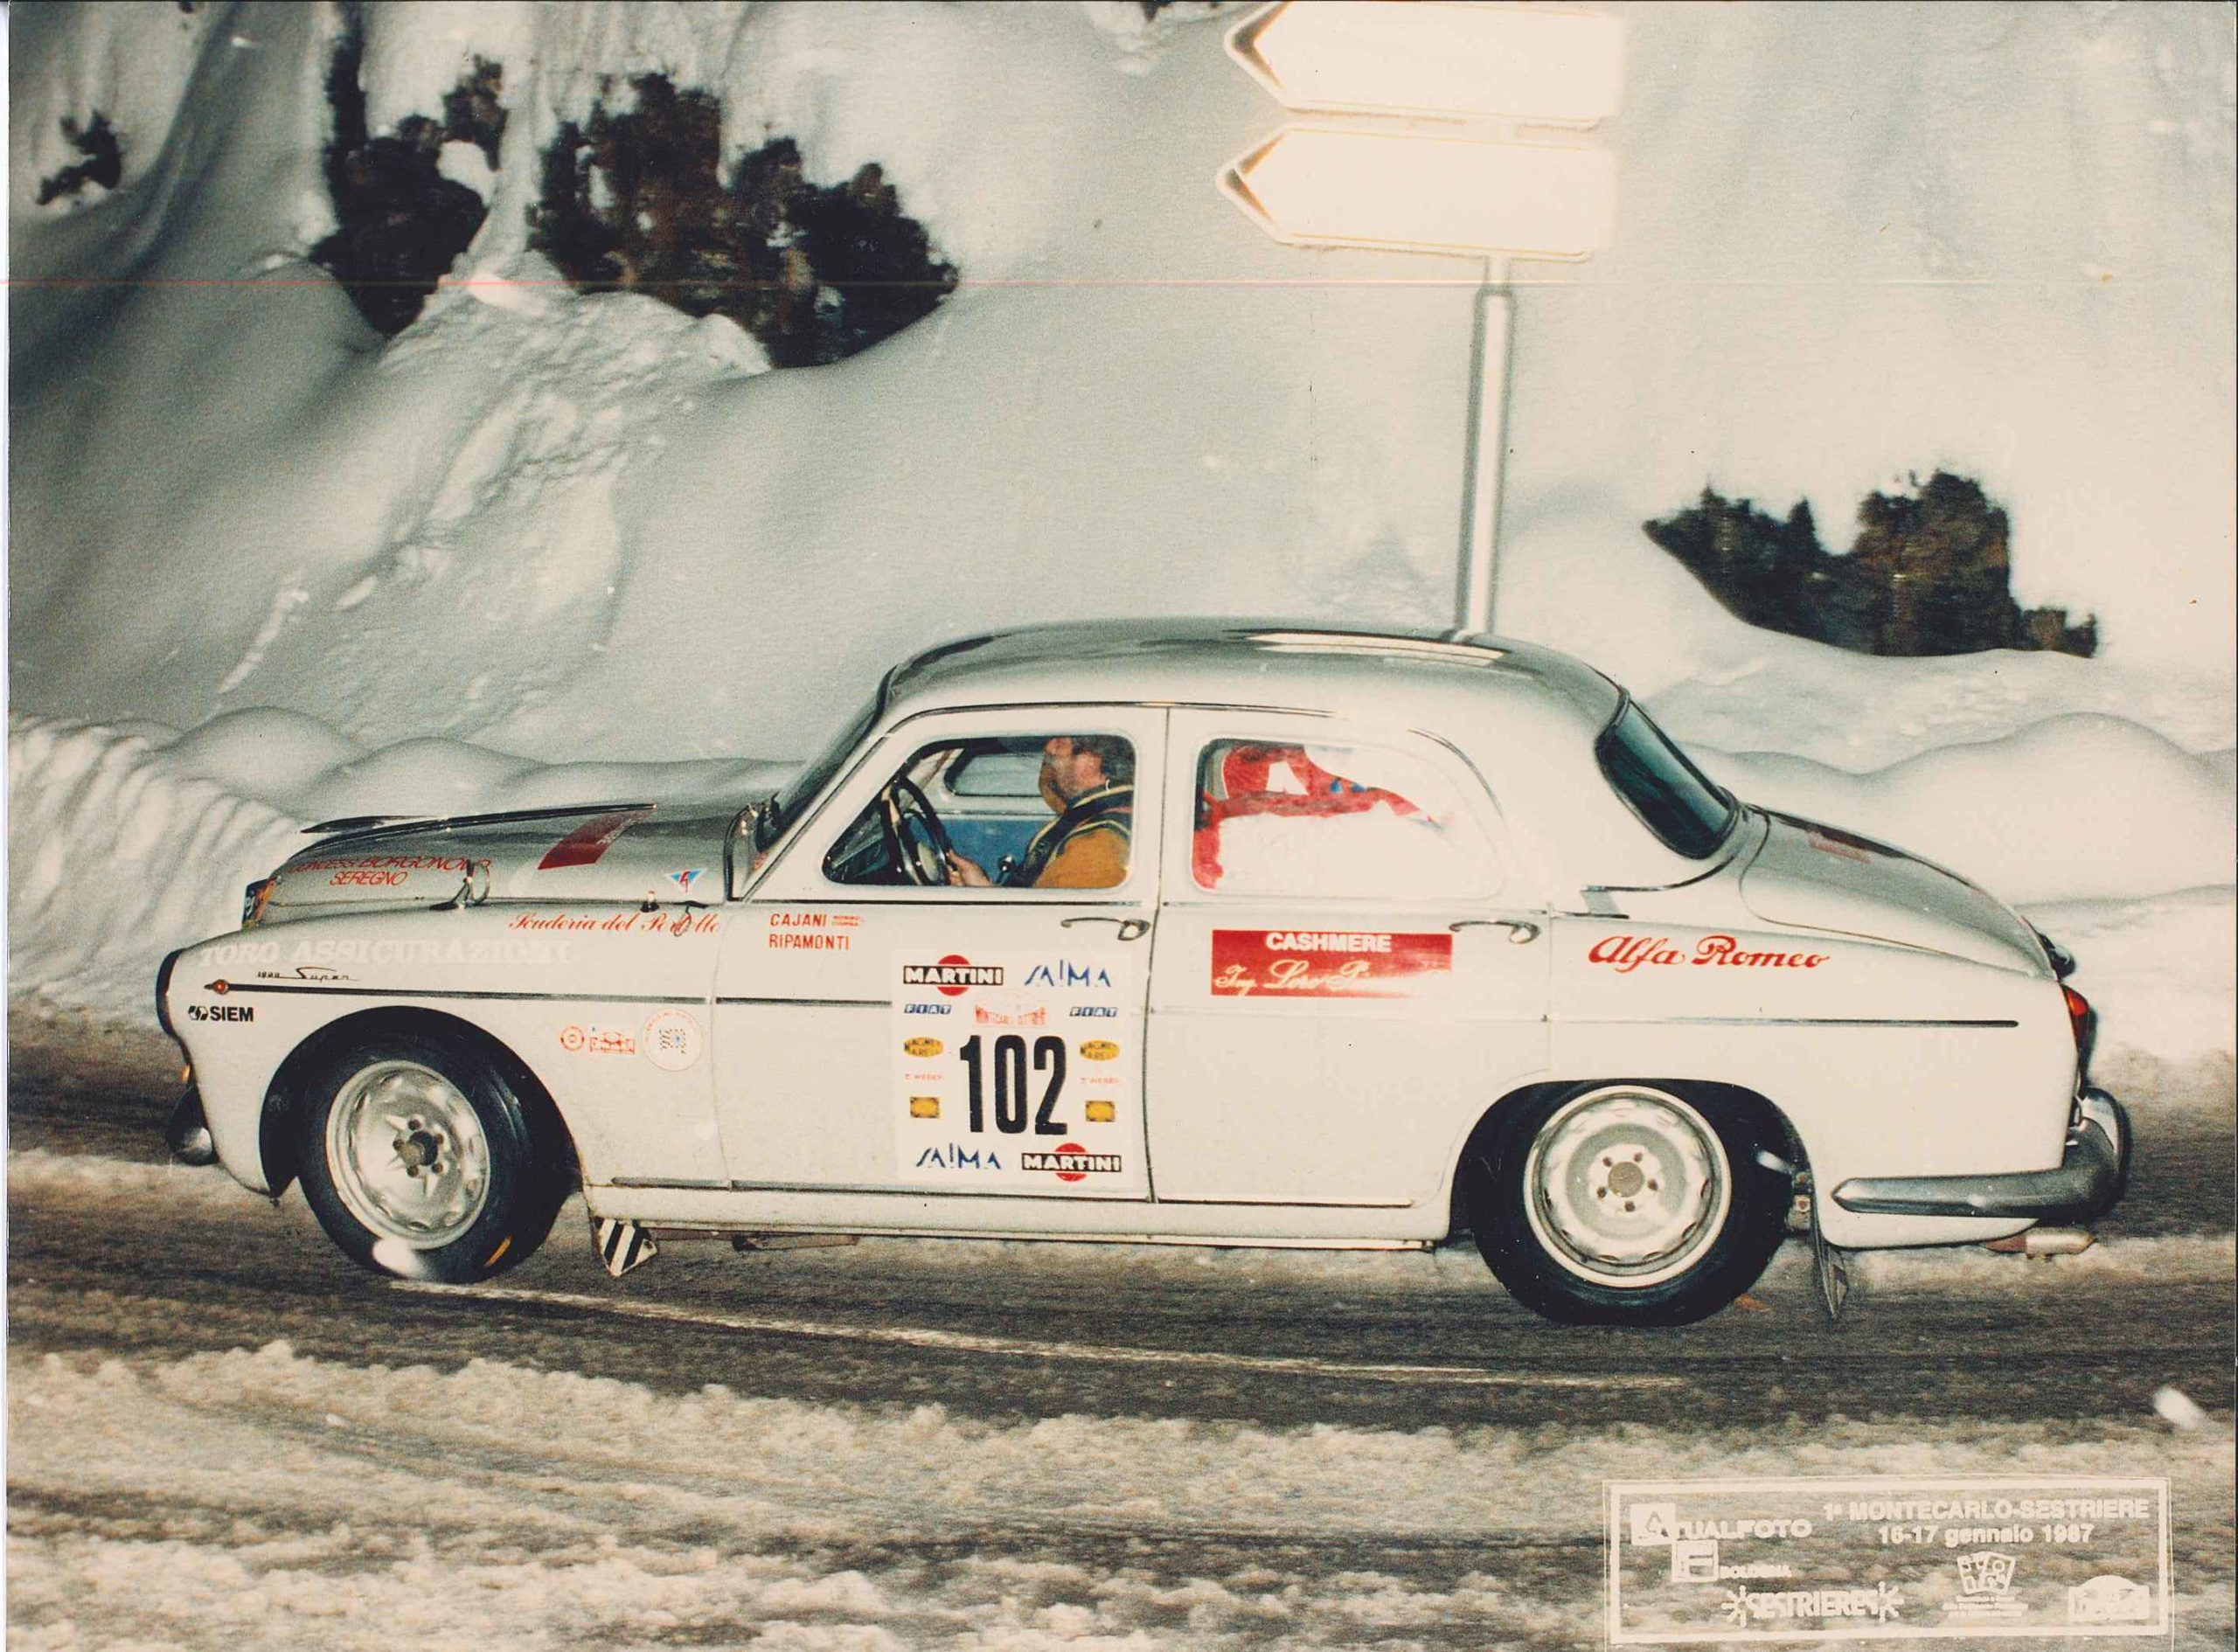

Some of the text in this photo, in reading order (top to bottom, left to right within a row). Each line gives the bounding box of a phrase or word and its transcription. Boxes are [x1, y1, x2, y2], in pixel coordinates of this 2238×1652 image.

[329, 871, 408, 886] SEREGNO
[770, 913, 828, 927] CAJANI
[769, 934, 850, 950] RIPAMONTI
[1266, 933, 1392, 952] CASHMERE
[201, 941, 280, 967] TORO
[1588, 934, 1830, 973] Alfa Romeo
[905, 967, 1002, 985] MARTINI
[210, 1005, 254, 1022] SIEM
[904, 1004, 952, 1014] FIAT
[1069, 1007, 1117, 1017] FIAT
[960, 1035, 1067, 1135] 102
[1023, 1155, 1120, 1171] MARTINI
